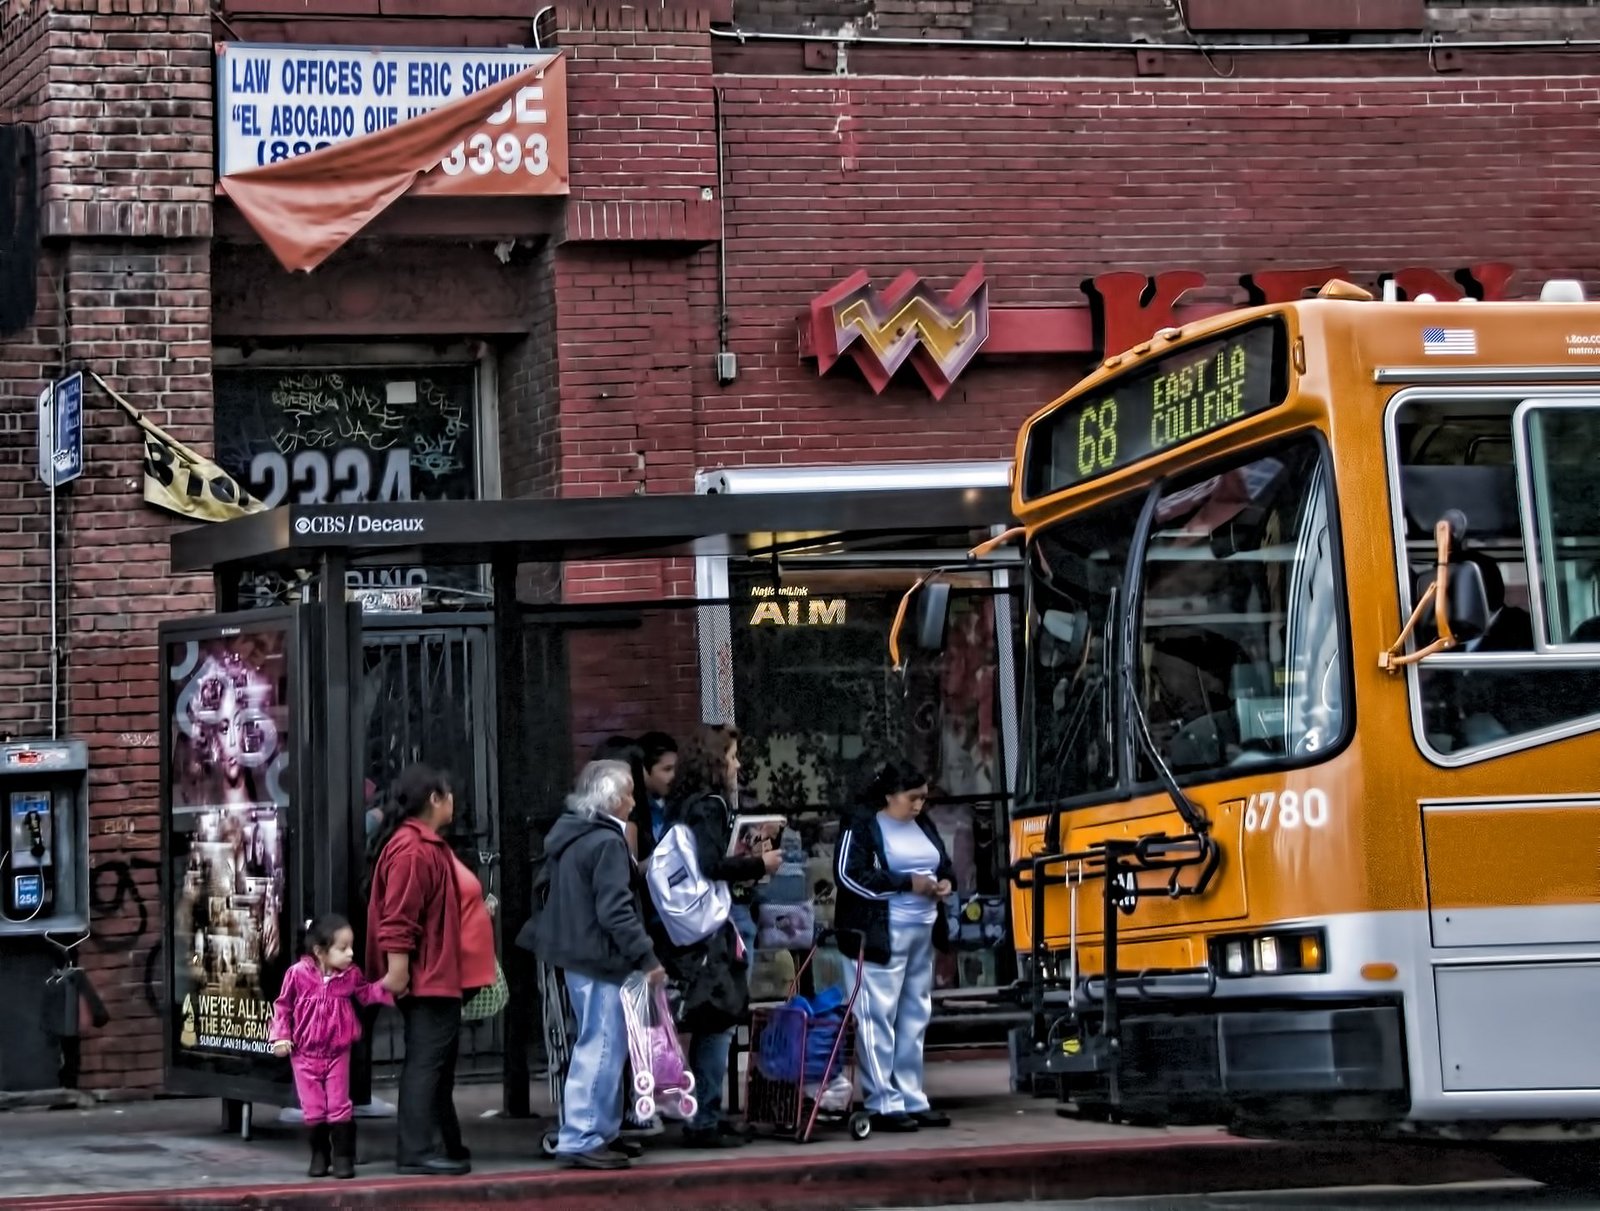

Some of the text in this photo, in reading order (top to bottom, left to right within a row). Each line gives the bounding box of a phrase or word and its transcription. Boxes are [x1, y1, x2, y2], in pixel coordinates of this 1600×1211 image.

[232, 58, 271, 94] LAW
[282, 58, 363, 96] OFFICES
[372, 61, 398, 96] OF
[407, 61, 452, 97] ERIC
[270, 104, 355, 138] ABOGADO
[1153, 345, 1246, 410] EAST LA
[1151, 379, 1246, 449] COLLEGE
[1078, 398, 1117, 475] 68
[311, 516, 345, 533] CBS
[358, 515, 424, 532] Decaux
[1305, 729, 1320, 752] 3
[1244, 788, 1329, 832] 6780
[199, 995, 275, 1020] WE'RE ALL FA
[199, 1016, 218, 1034] THE
[200, 1034, 222, 1048] SUNDAY
[222, 1037, 235, 1048] JAN
[251, 1041, 267, 1053] ONLY
